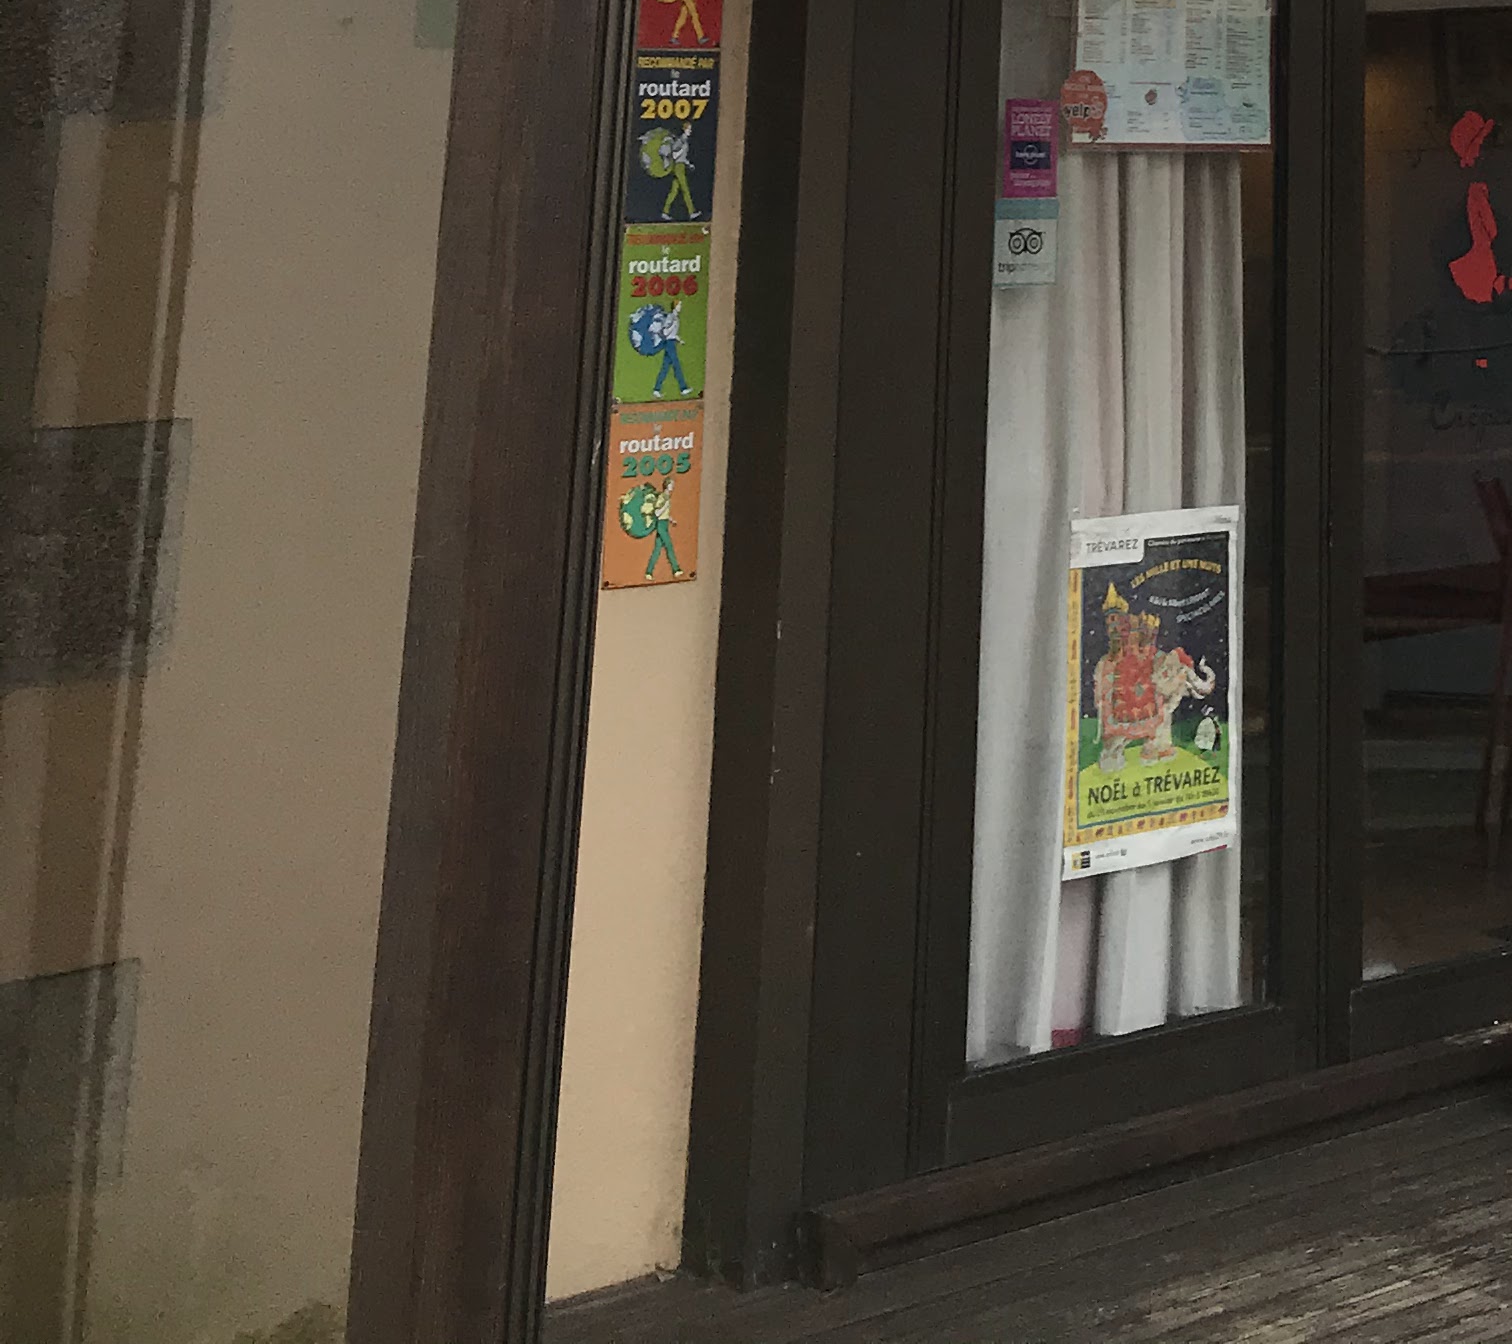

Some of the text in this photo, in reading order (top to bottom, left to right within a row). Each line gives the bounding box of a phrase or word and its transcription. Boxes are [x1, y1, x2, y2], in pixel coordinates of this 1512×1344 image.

[638, 79, 711, 97] routard
[640, 97, 709, 120] 2007
[1010, 113, 1052, 125] LONELY
[1064, 103, 1090, 119] yelp
[1010, 125, 1052, 137] PLANET
[628, 255, 701, 274] routard
[631, 274, 698, 297] 2006
[619, 431, 695, 454] routard
[621, 452, 691, 478] 2005
[1087, 778, 1128, 806] NOËL
[1132, 782, 1141, 798] à
[1144, 766, 1220, 795] TRÉVAREZ
